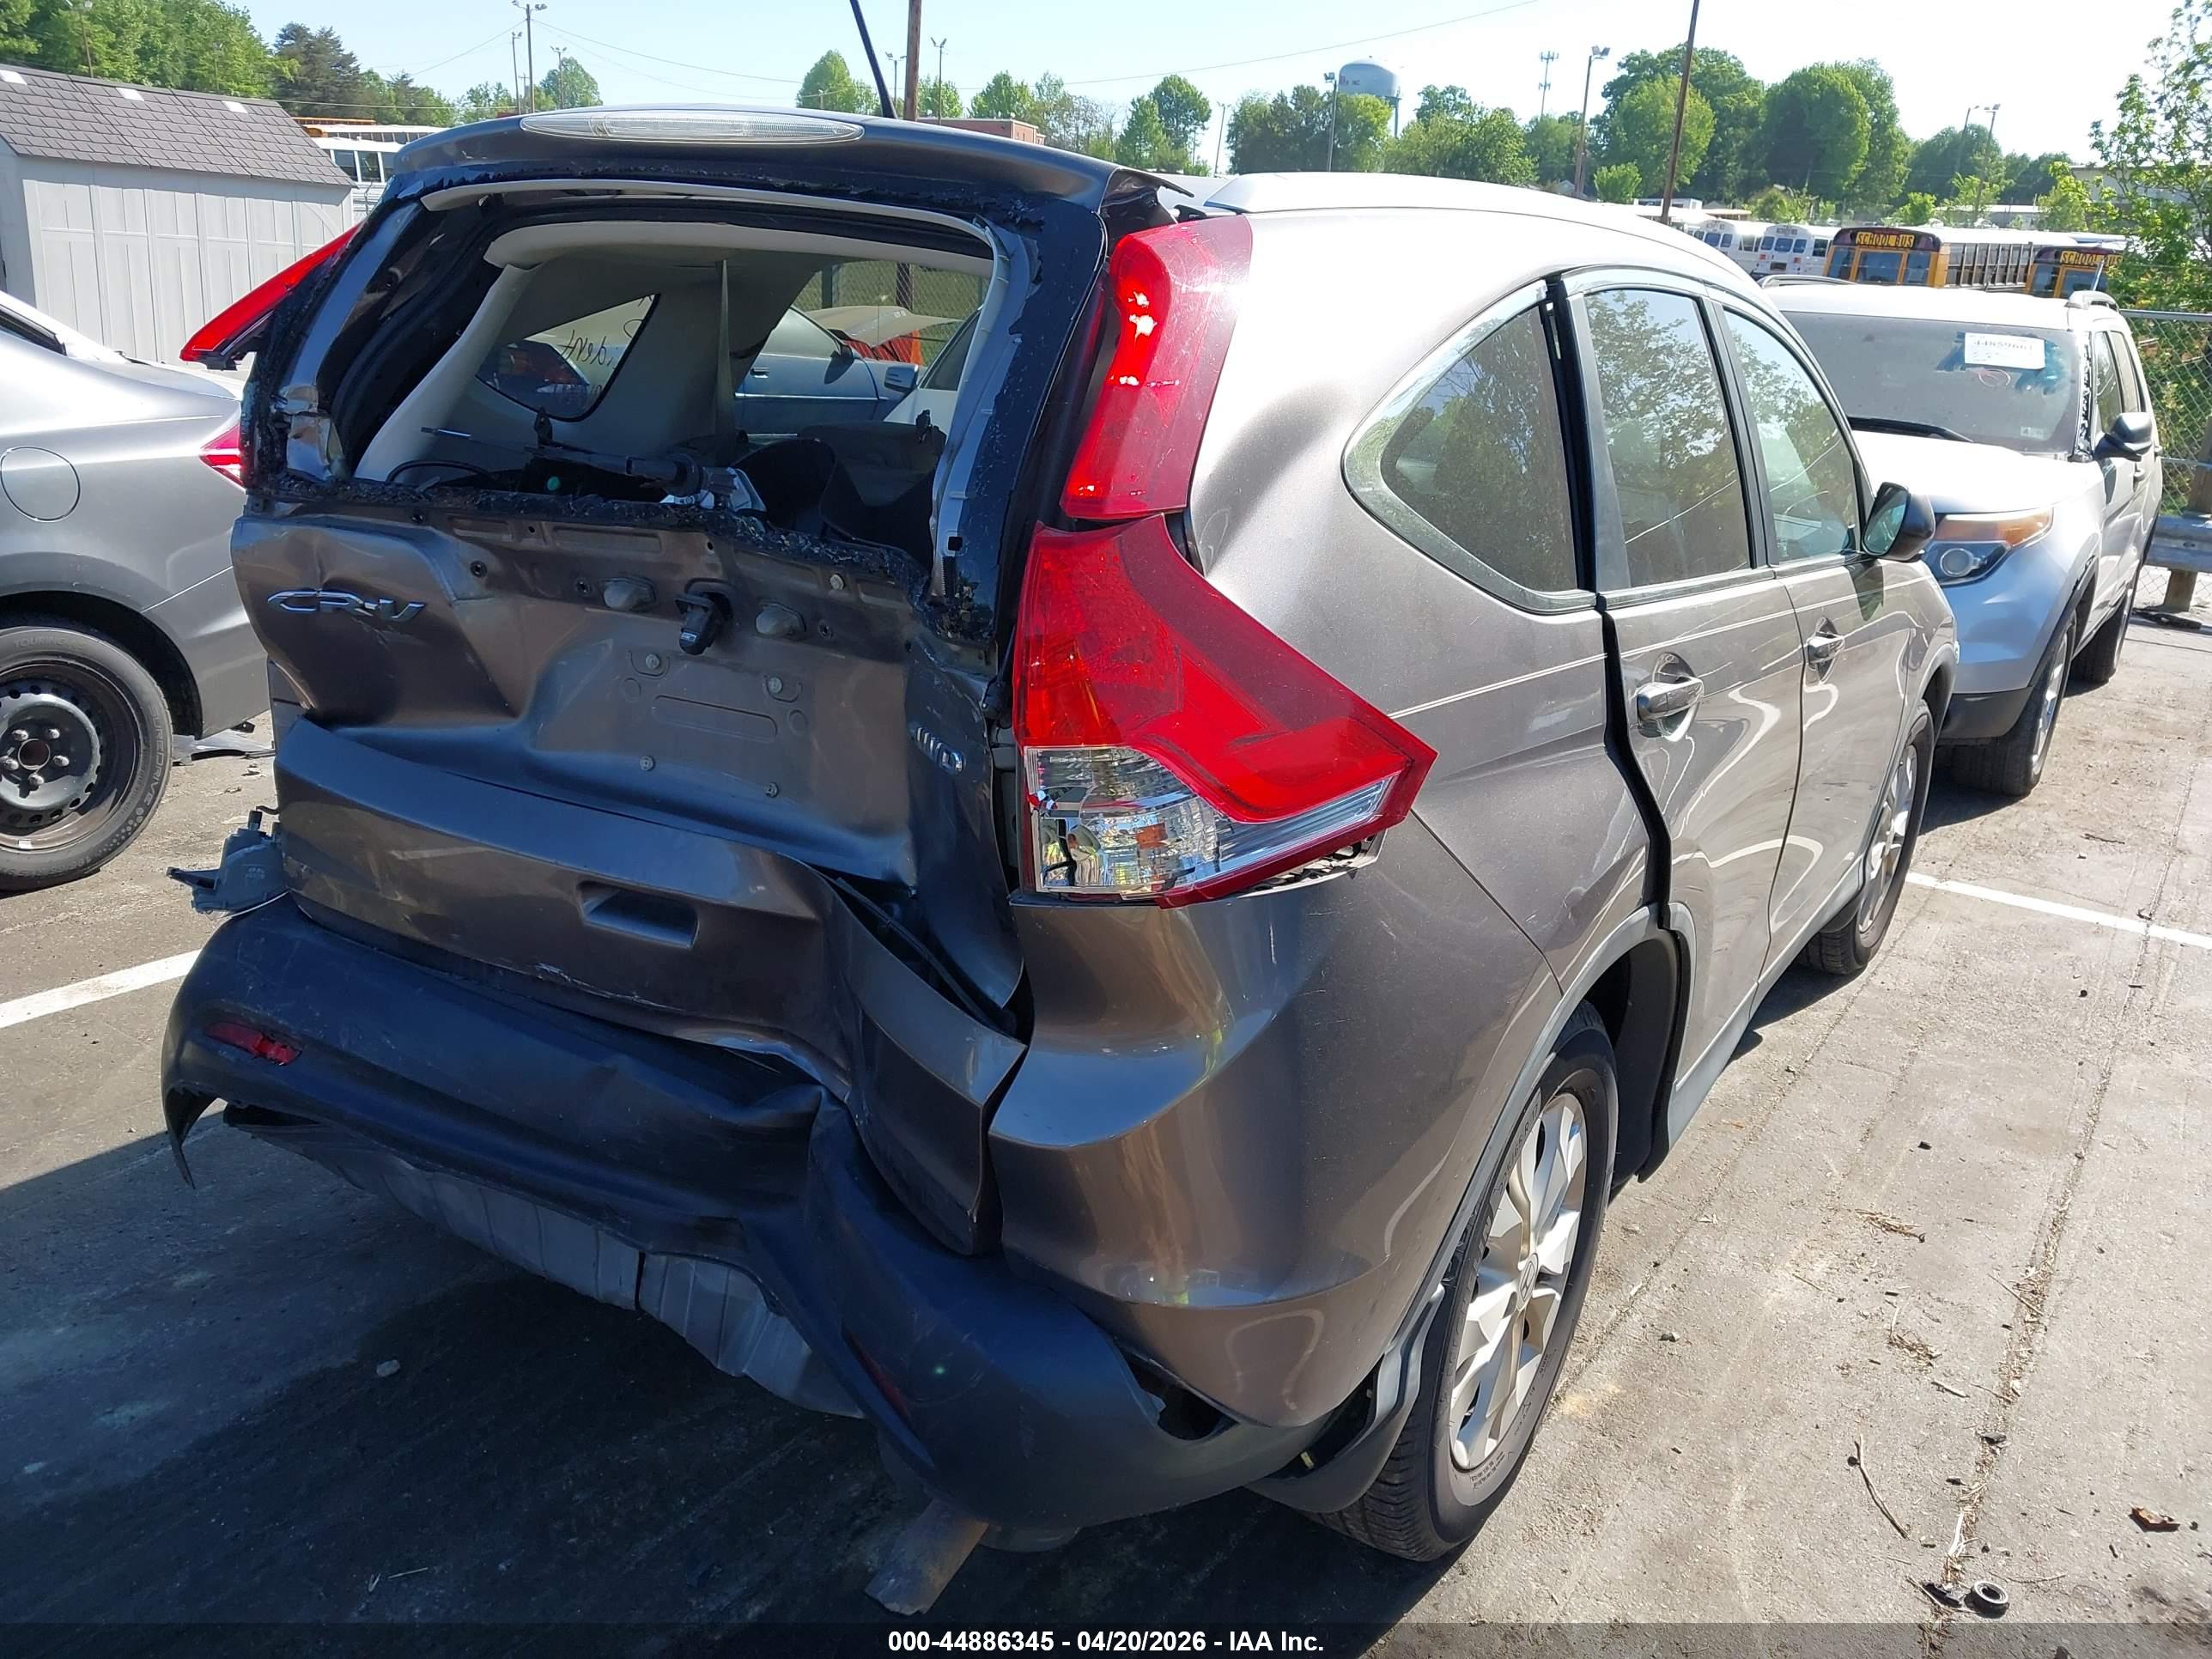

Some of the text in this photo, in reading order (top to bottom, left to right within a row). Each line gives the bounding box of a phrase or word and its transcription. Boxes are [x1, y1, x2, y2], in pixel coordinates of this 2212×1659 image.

[1857, 233, 1914, 250] SCHOOL BUS
[2063, 252, 2096, 265] SCHOOL
